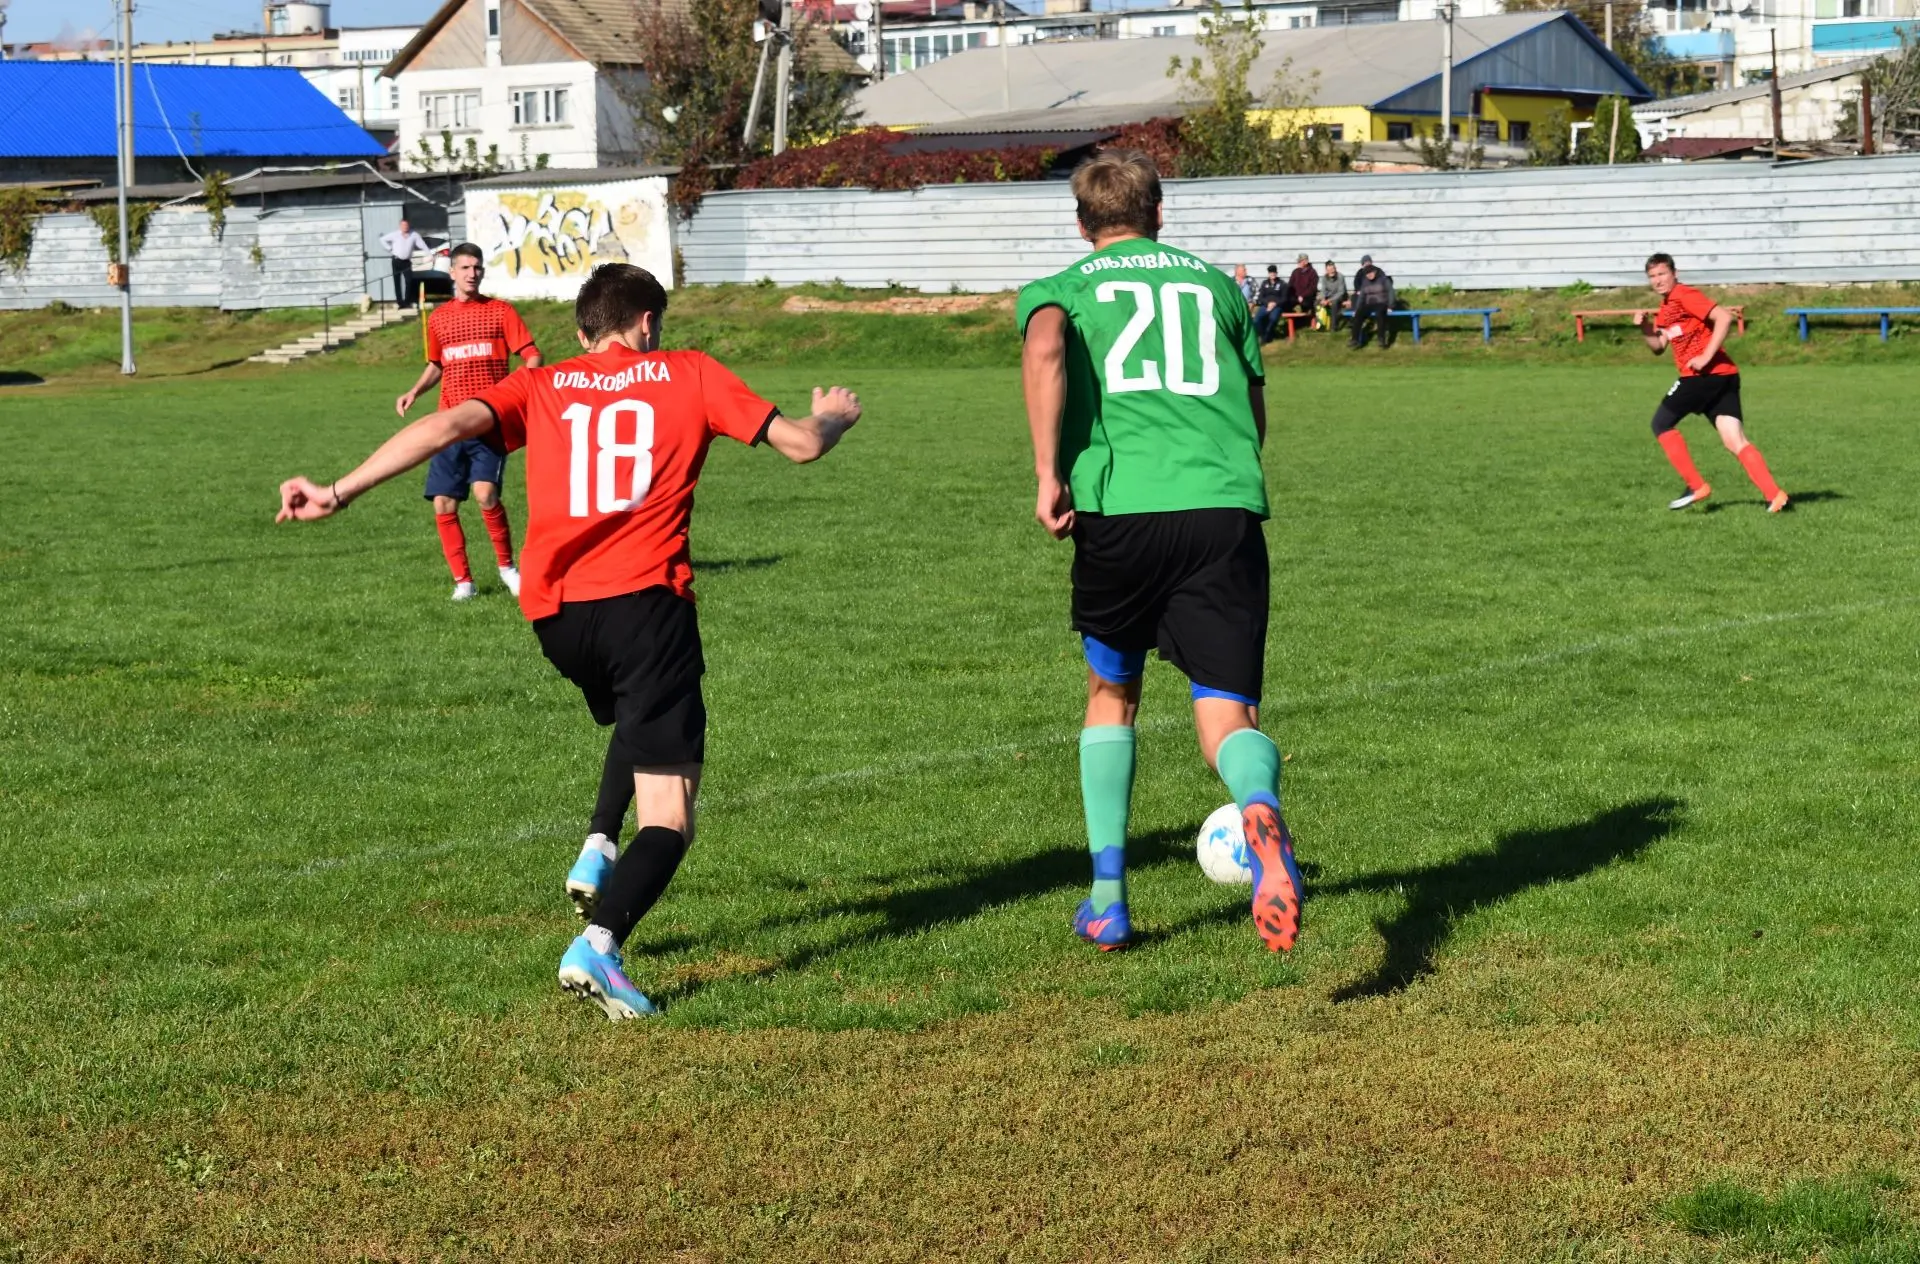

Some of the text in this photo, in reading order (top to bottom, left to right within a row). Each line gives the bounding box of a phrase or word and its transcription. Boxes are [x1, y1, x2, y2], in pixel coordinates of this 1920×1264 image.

[1080, 251, 1207, 274] ОЛЬХОВАТКА
[1095, 281, 1219, 396] 20
[553, 361, 670, 391] ОЛЬХОВАТКА
[561, 399, 654, 517] 18
